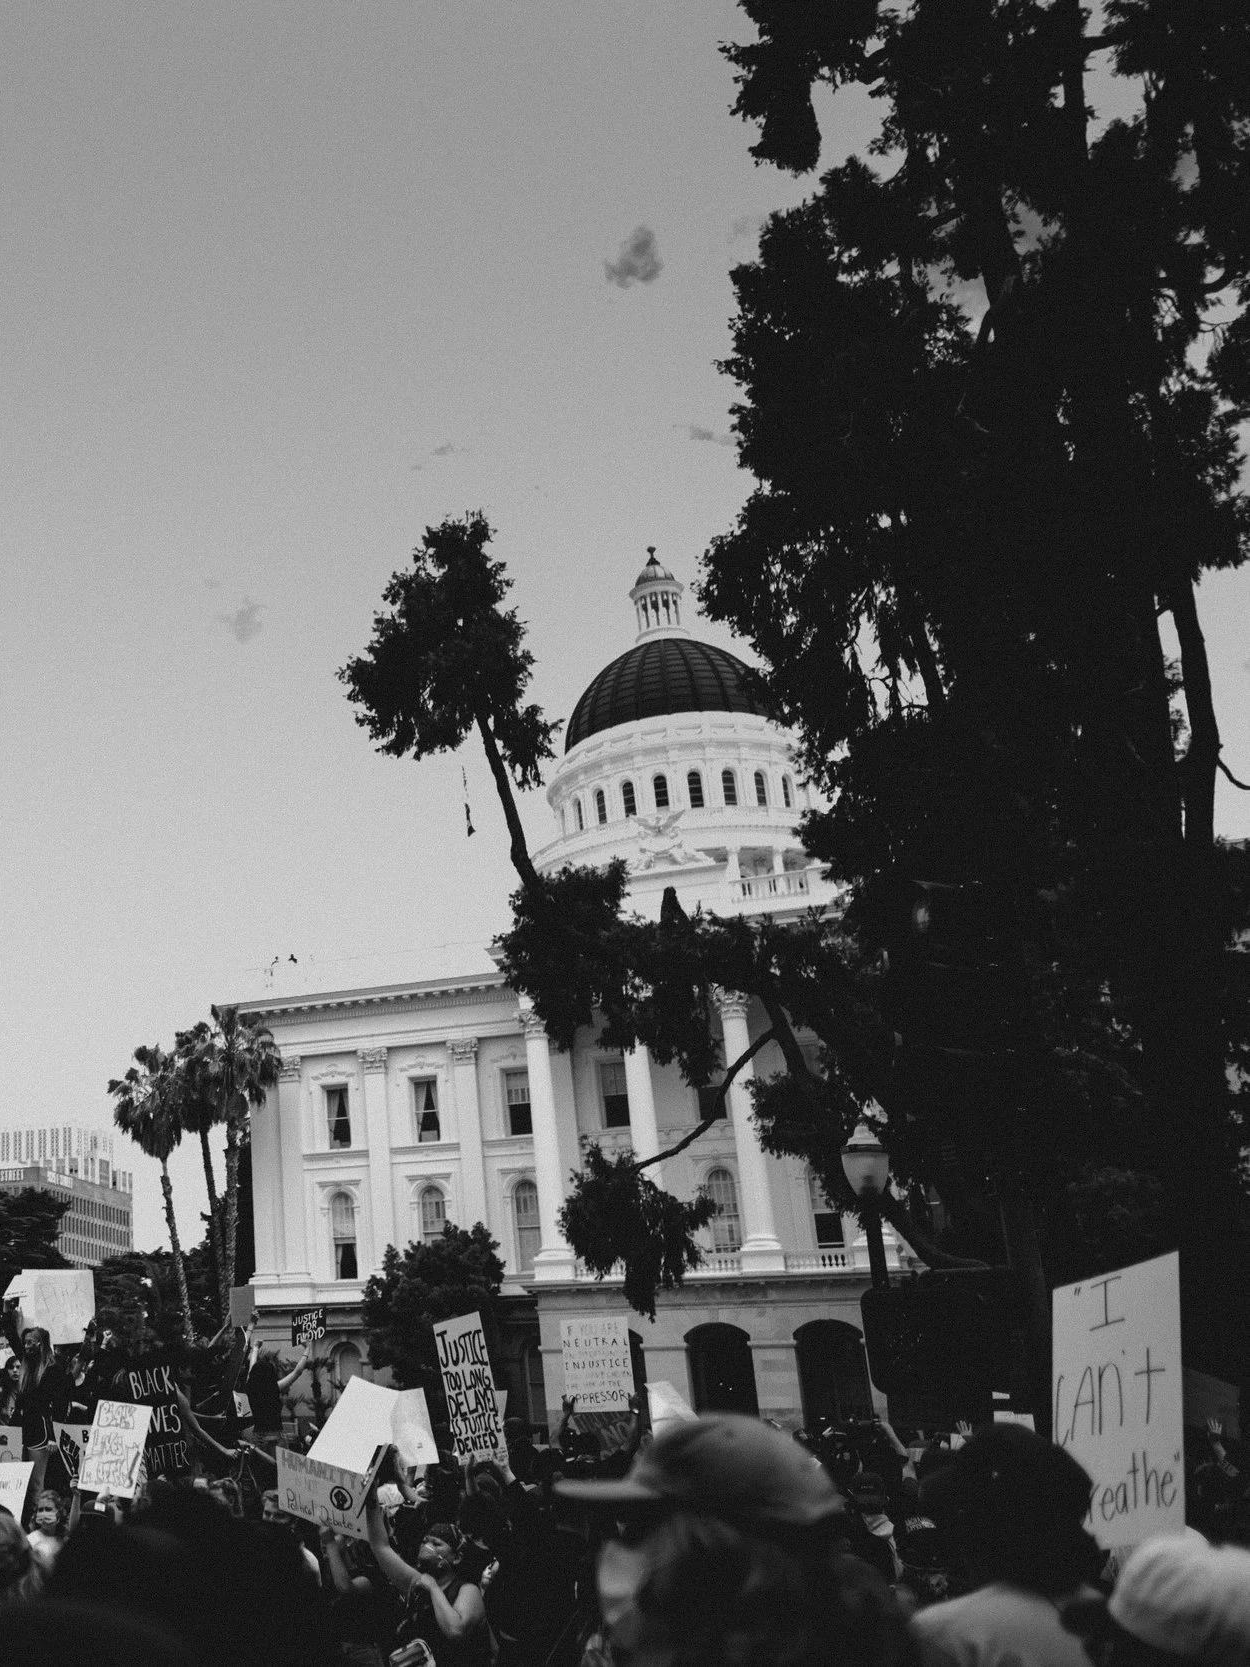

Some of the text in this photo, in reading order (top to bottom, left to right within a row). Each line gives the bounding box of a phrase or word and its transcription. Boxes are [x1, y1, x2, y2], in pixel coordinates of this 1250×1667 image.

[0, 1169, 24, 1182] STREET
[292, 1309, 323, 1326] JUSTICE
[302, 1320, 318, 1331] FOR
[436, 1329, 489, 1369] JUSTICE
[563, 1337, 628, 1348] NEUTRAL
[565, 1357, 629, 1371] INJUSTICE
[129, 1365, 175, 1400] BLACK
[443, 1368, 491, 1392] TOO LONG
[451, 1412, 502, 1439] IS JUSTICE
[456, 1431, 499, 1456] DENIED
[286, 1488, 315, 1518] Political
